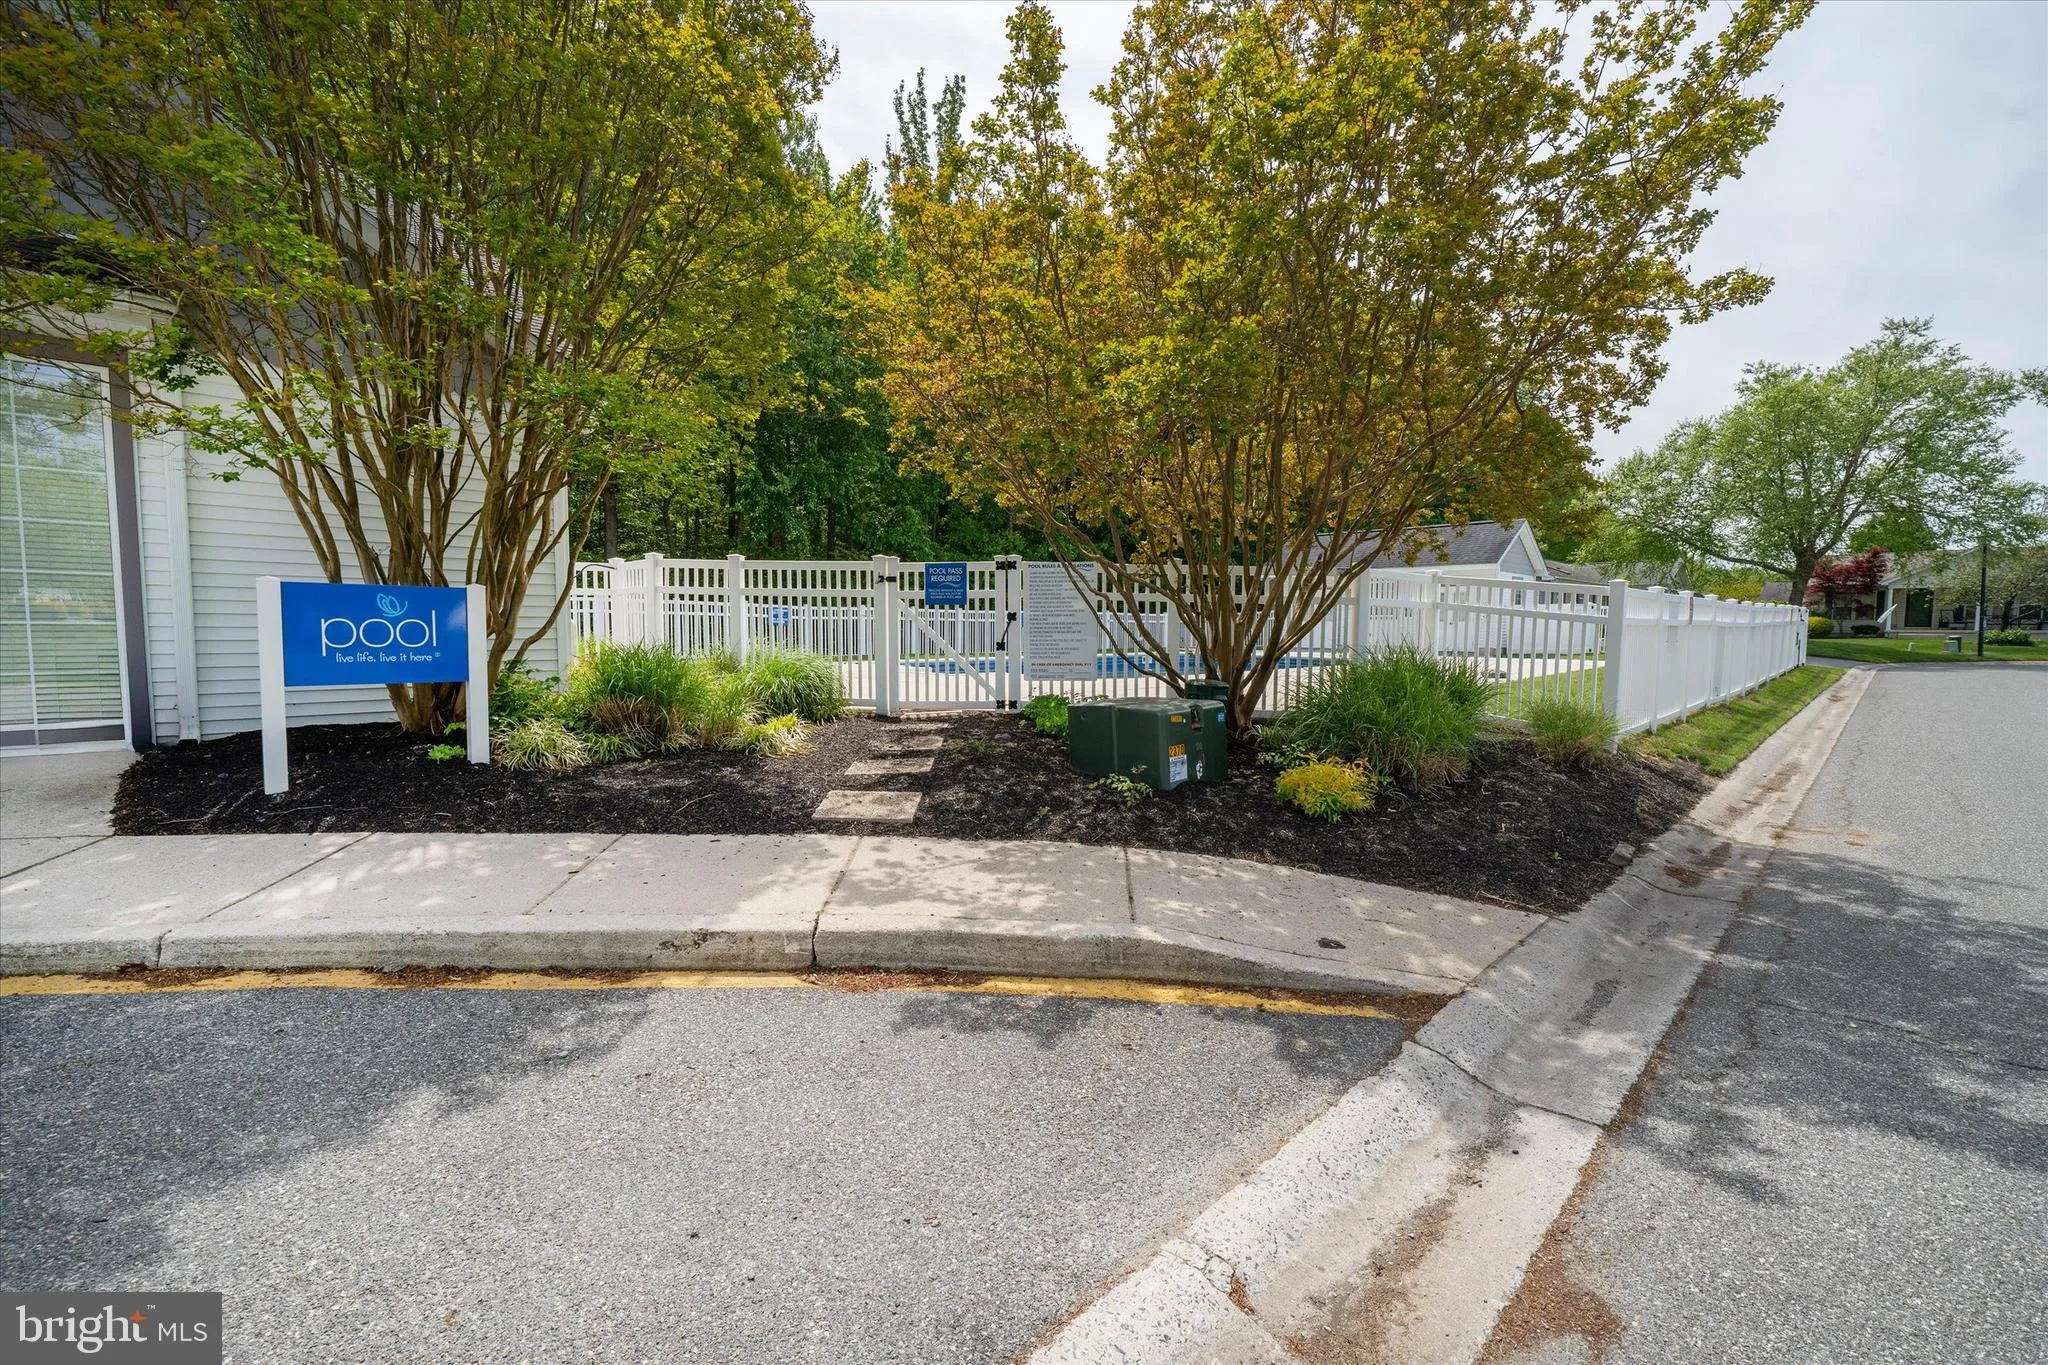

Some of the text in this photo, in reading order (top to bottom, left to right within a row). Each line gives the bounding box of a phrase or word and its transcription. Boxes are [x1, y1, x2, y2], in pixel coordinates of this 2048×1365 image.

[929, 567, 947, 575] POOL
[321, 609, 437, 657] pool
[336, 651, 433, 663] live life. live it here
